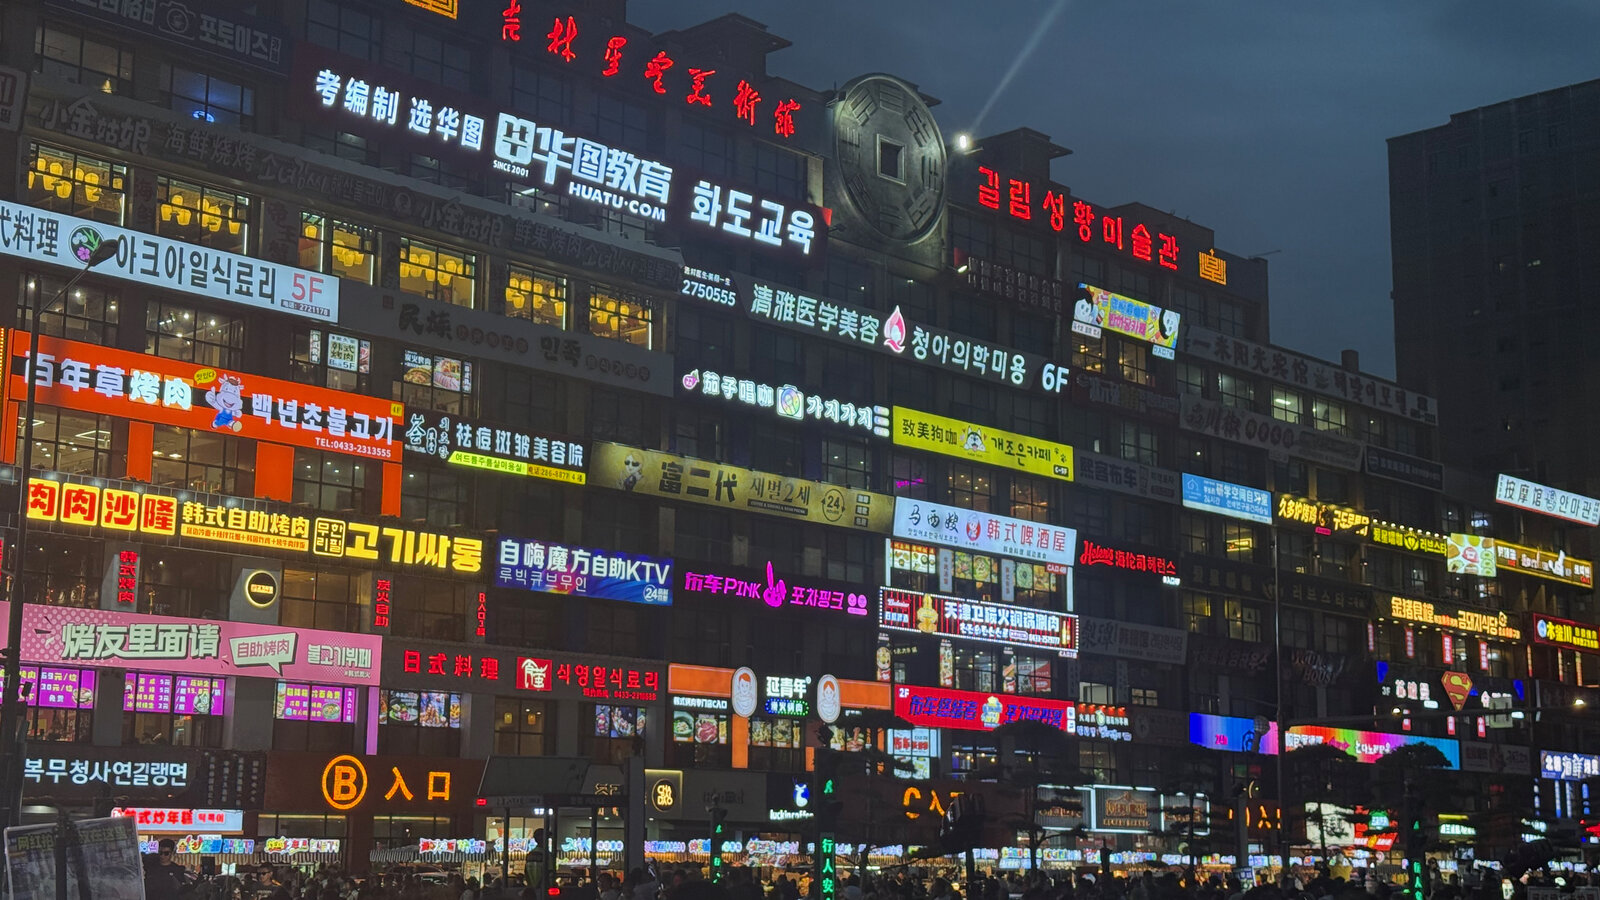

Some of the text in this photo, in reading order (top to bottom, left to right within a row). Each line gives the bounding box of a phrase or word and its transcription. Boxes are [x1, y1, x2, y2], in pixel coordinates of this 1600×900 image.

[199, 14, 269, 60] 포토이즈
[316, 69, 485, 151] 考编制 选华图
[40, 97, 151, 157] 小金姑娘
[165, 120, 255, 171] 海鲜烧烤
[493, 160, 530, 178] SINCE 2001
[532, 127, 674, 204] 华图教育
[420, 197, 504, 248] 小金姑娘
[690, 180, 816, 255] 화도교육
[115, 234, 276, 304] 아크아일식료리
[291, 273, 325, 303] 5F
[682, 280, 737, 307] 2750555
[751, 283, 880, 345] 清雅医学美容
[912, 325, 1027, 385] 청아의학미용
[702, 371, 775, 408] 茄子唱咖
[1041, 363, 1070, 393] 6F
[252, 393, 393, 446] 백년초불고기
[806, 395, 874, 431] 가지가지
[315, 436, 392, 458] TEL:0433-2313555
[455, 422, 584, 468] 祛痘斑皱美容院
[902, 417, 958, 446] 致美狗咖
[991, 436, 1051, 467] 개조은카페
[658, 461, 738, 503] 富二代
[1503, 479, 1543, 507] 按摩馆
[29, 483, 177, 531] 肉肉沙隆
[826, 495, 840, 509] 24
[1559, 494, 1593, 520] 안마관
[182, 501, 310, 539] 韩式自助烤肉
[986, 518, 1067, 553] 韩式啤酒屋
[345, 522, 483, 573] 고기싸롱
[1115, 550, 1147, 572] 海伦司
[499, 567, 588, 593] 루빅큐브무인
[374, 579, 391, 628] 炭火自助
[789, 586, 845, 610] 포차핑크
[61, 622, 221, 660] 烤友里面请
[236, 640, 290, 659] 自助烤肉
[307, 644, 372, 669] 불고기뷔페
[403, 649, 499, 681] 日式料理
[556, 663, 659, 691] 식영일식료리
[766, 676, 808, 699] 延青年
[898, 688, 910, 698] 2F
[24, 758, 189, 788] 복무청사연길랭면
[332, 764, 451, 801] B 入口
[821, 838, 834, 900] 行人安
